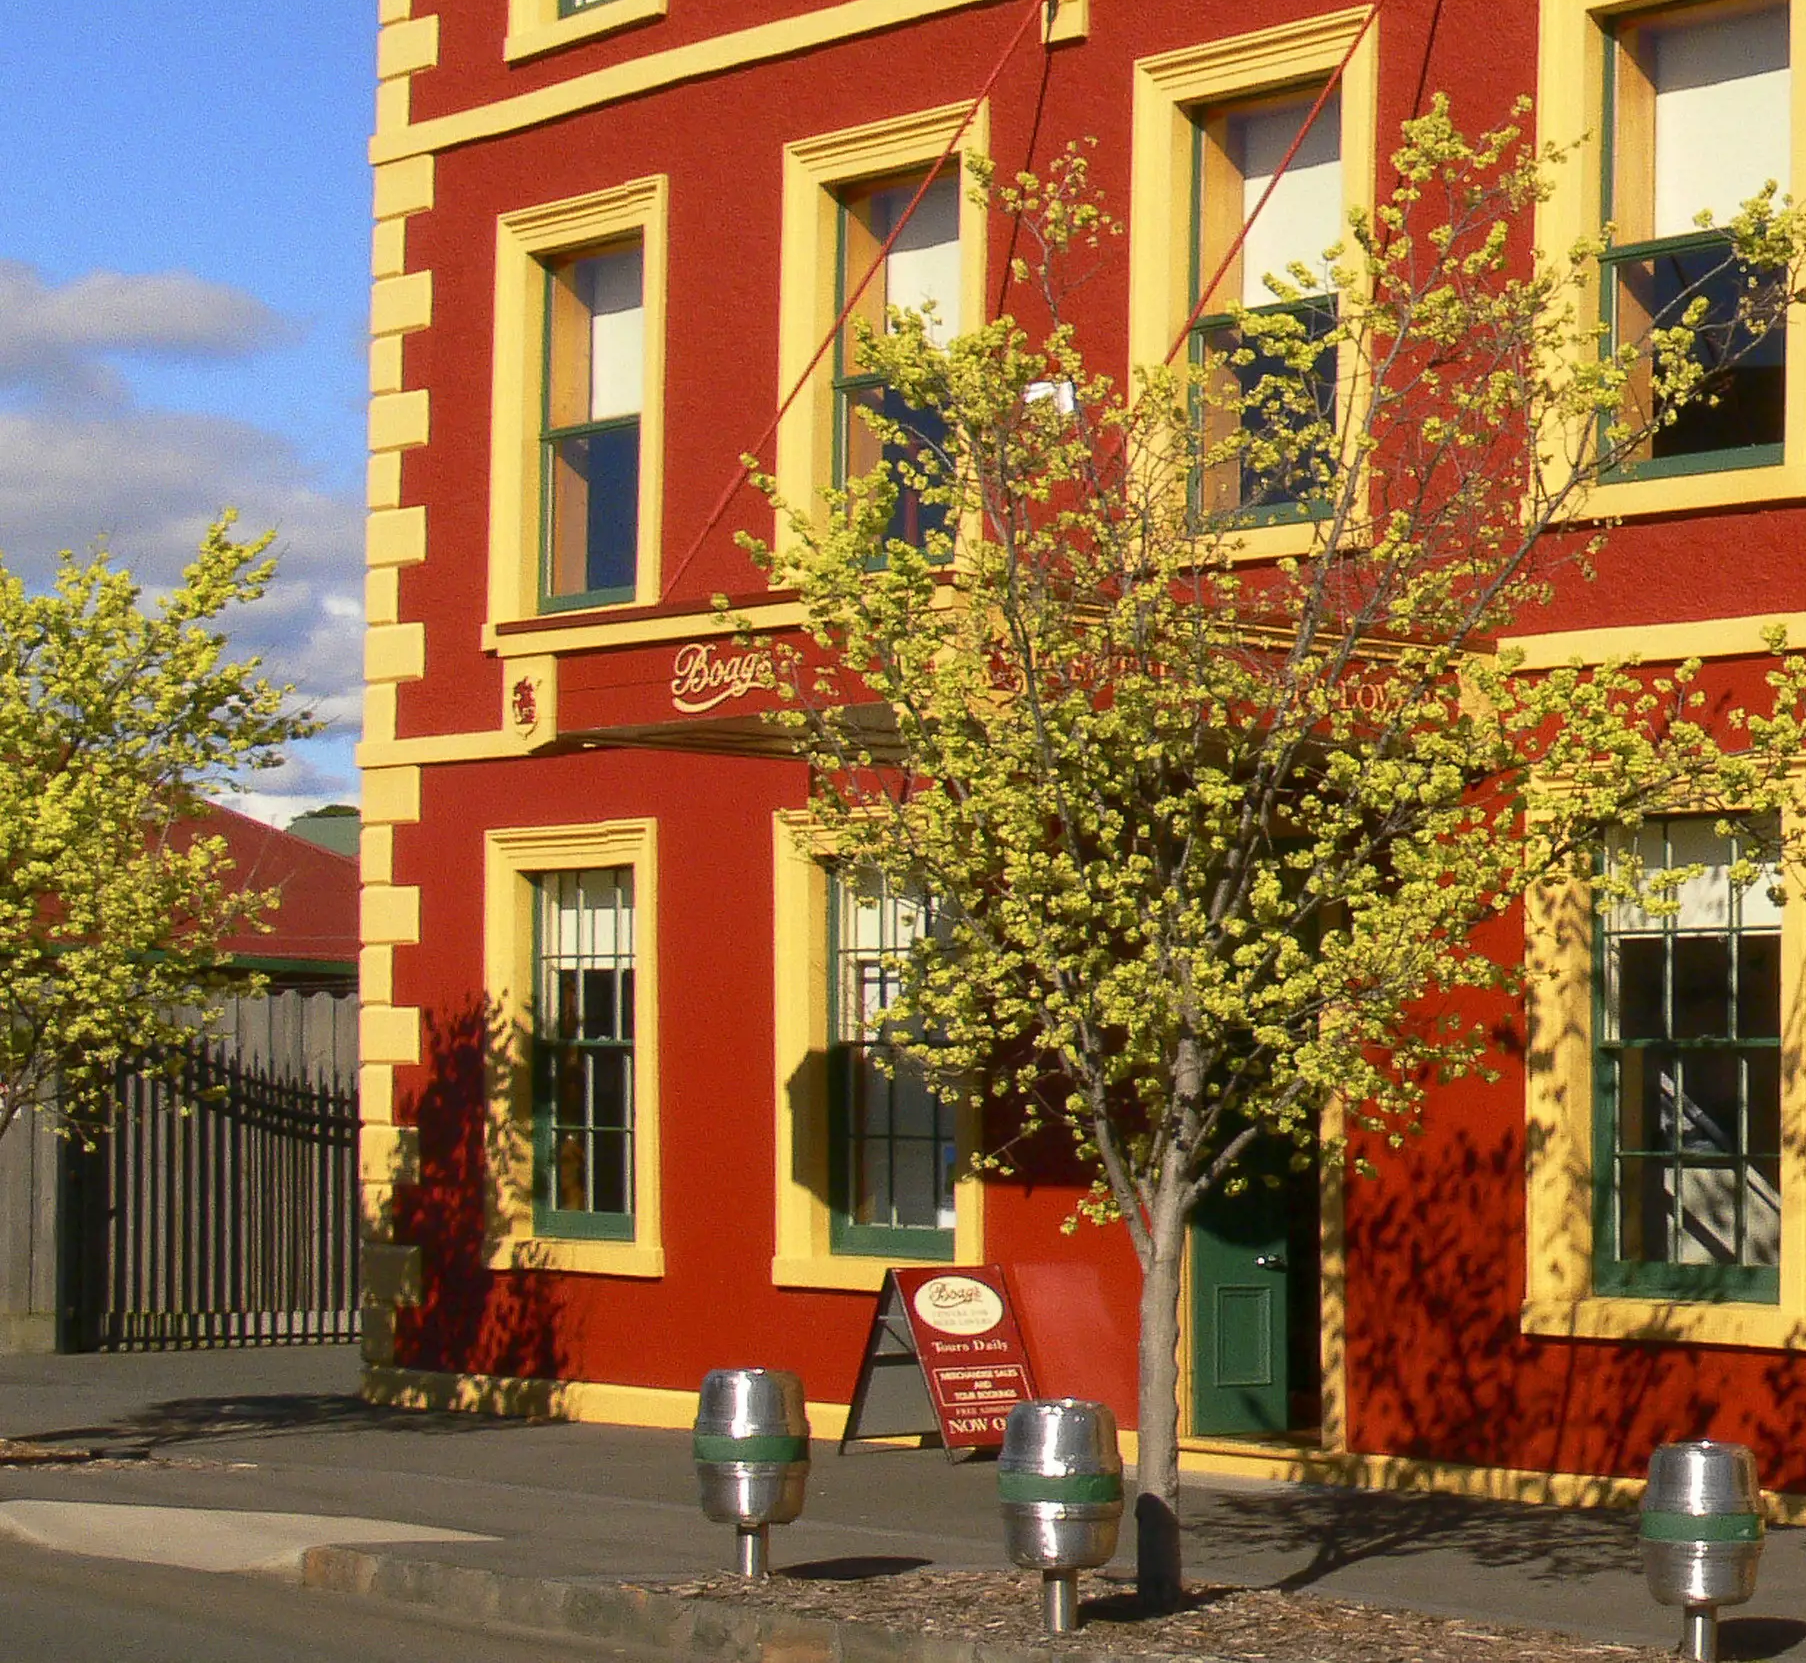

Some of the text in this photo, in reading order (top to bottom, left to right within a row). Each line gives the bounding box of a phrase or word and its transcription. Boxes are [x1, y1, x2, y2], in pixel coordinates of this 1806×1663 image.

[931, 1338, 1008, 1354] Tours Daily
[948, 1417, 988, 1435] NOW
